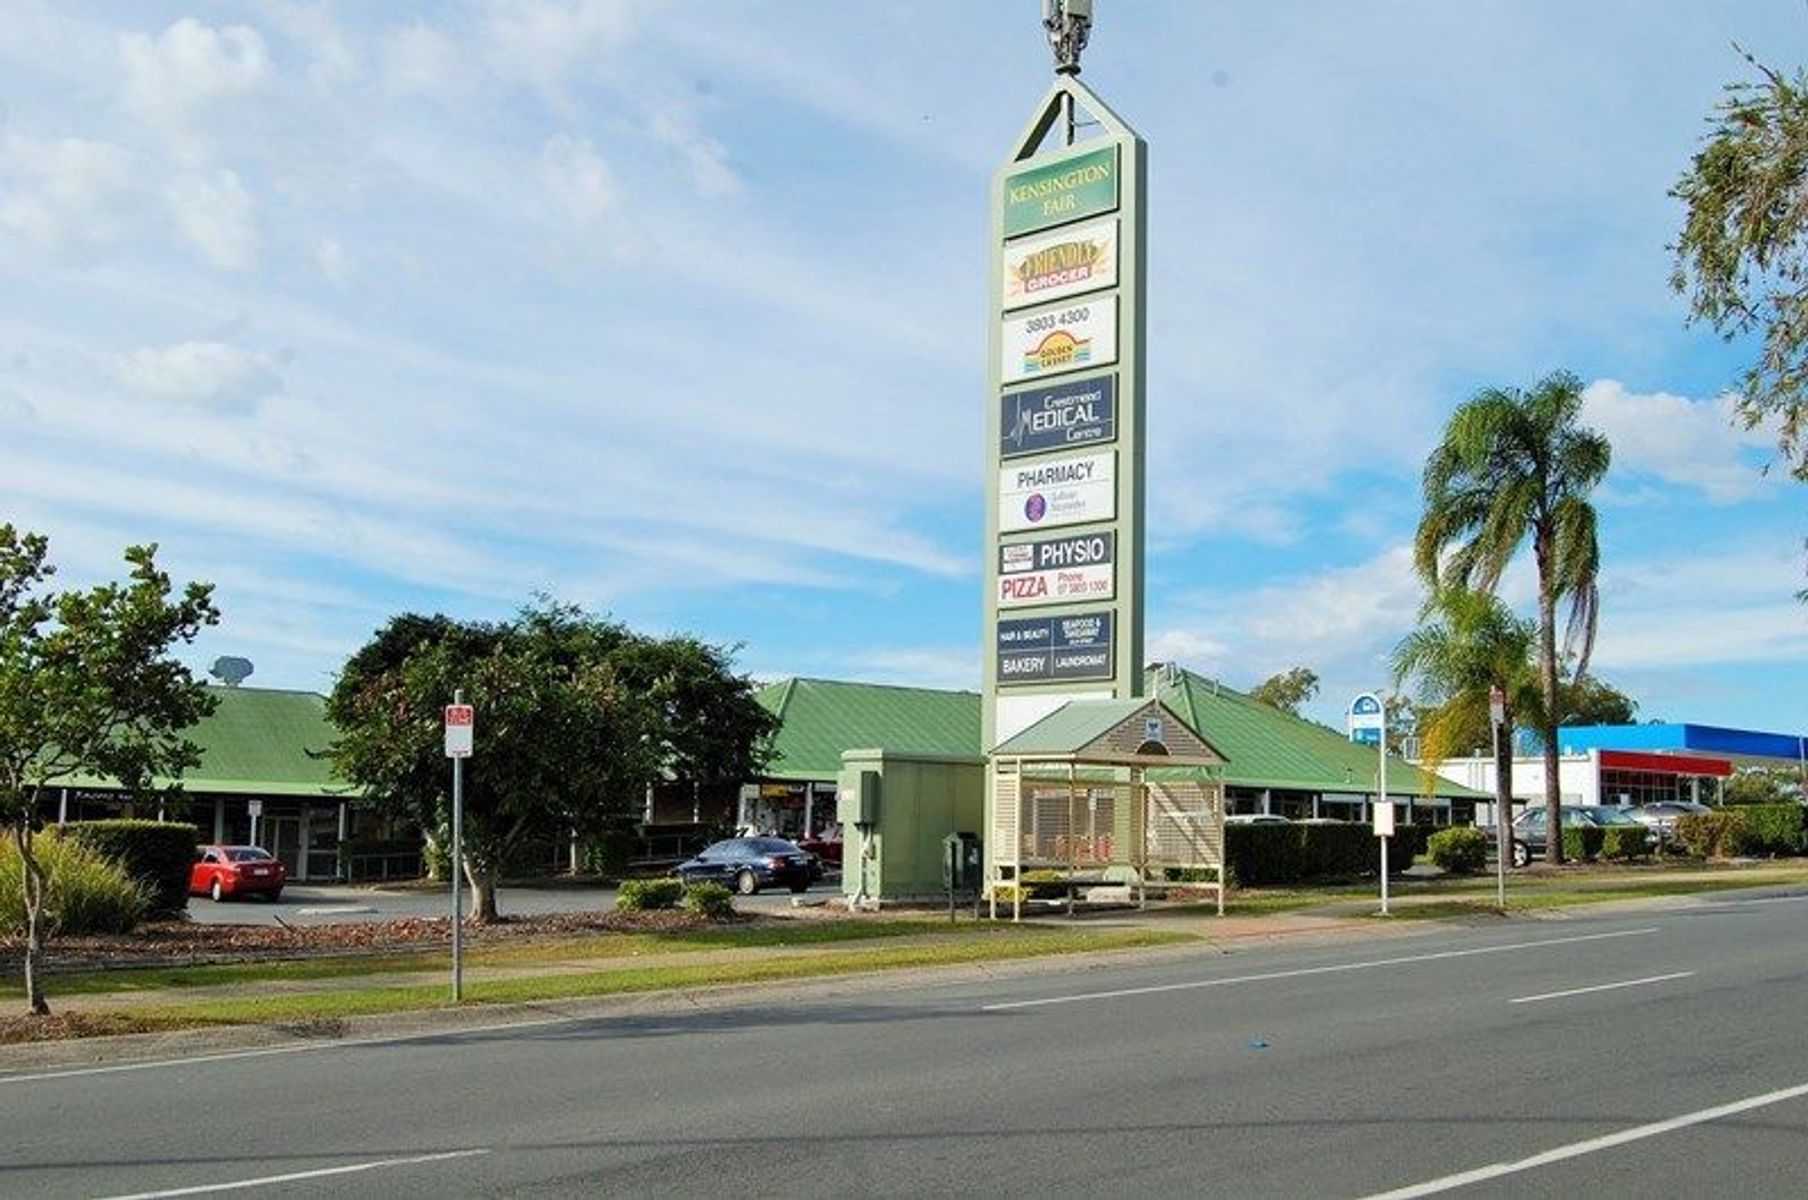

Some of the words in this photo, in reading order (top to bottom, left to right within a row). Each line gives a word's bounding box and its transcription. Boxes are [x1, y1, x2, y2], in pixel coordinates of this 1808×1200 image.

[1010, 163, 1109, 204] KENSINGTON
[1044, 194, 1075, 216] FAIR
[1027, 267, 1089, 290] GROCER
[1020, 402, 1099, 435] MEDICAL
[1017, 461, 1094, 488] PHARMACY
[1041, 538, 1105, 566] PHYSIO
[1002, 577, 1048, 600] PIZZA
[1003, 657, 1046, 675] BAKERY
